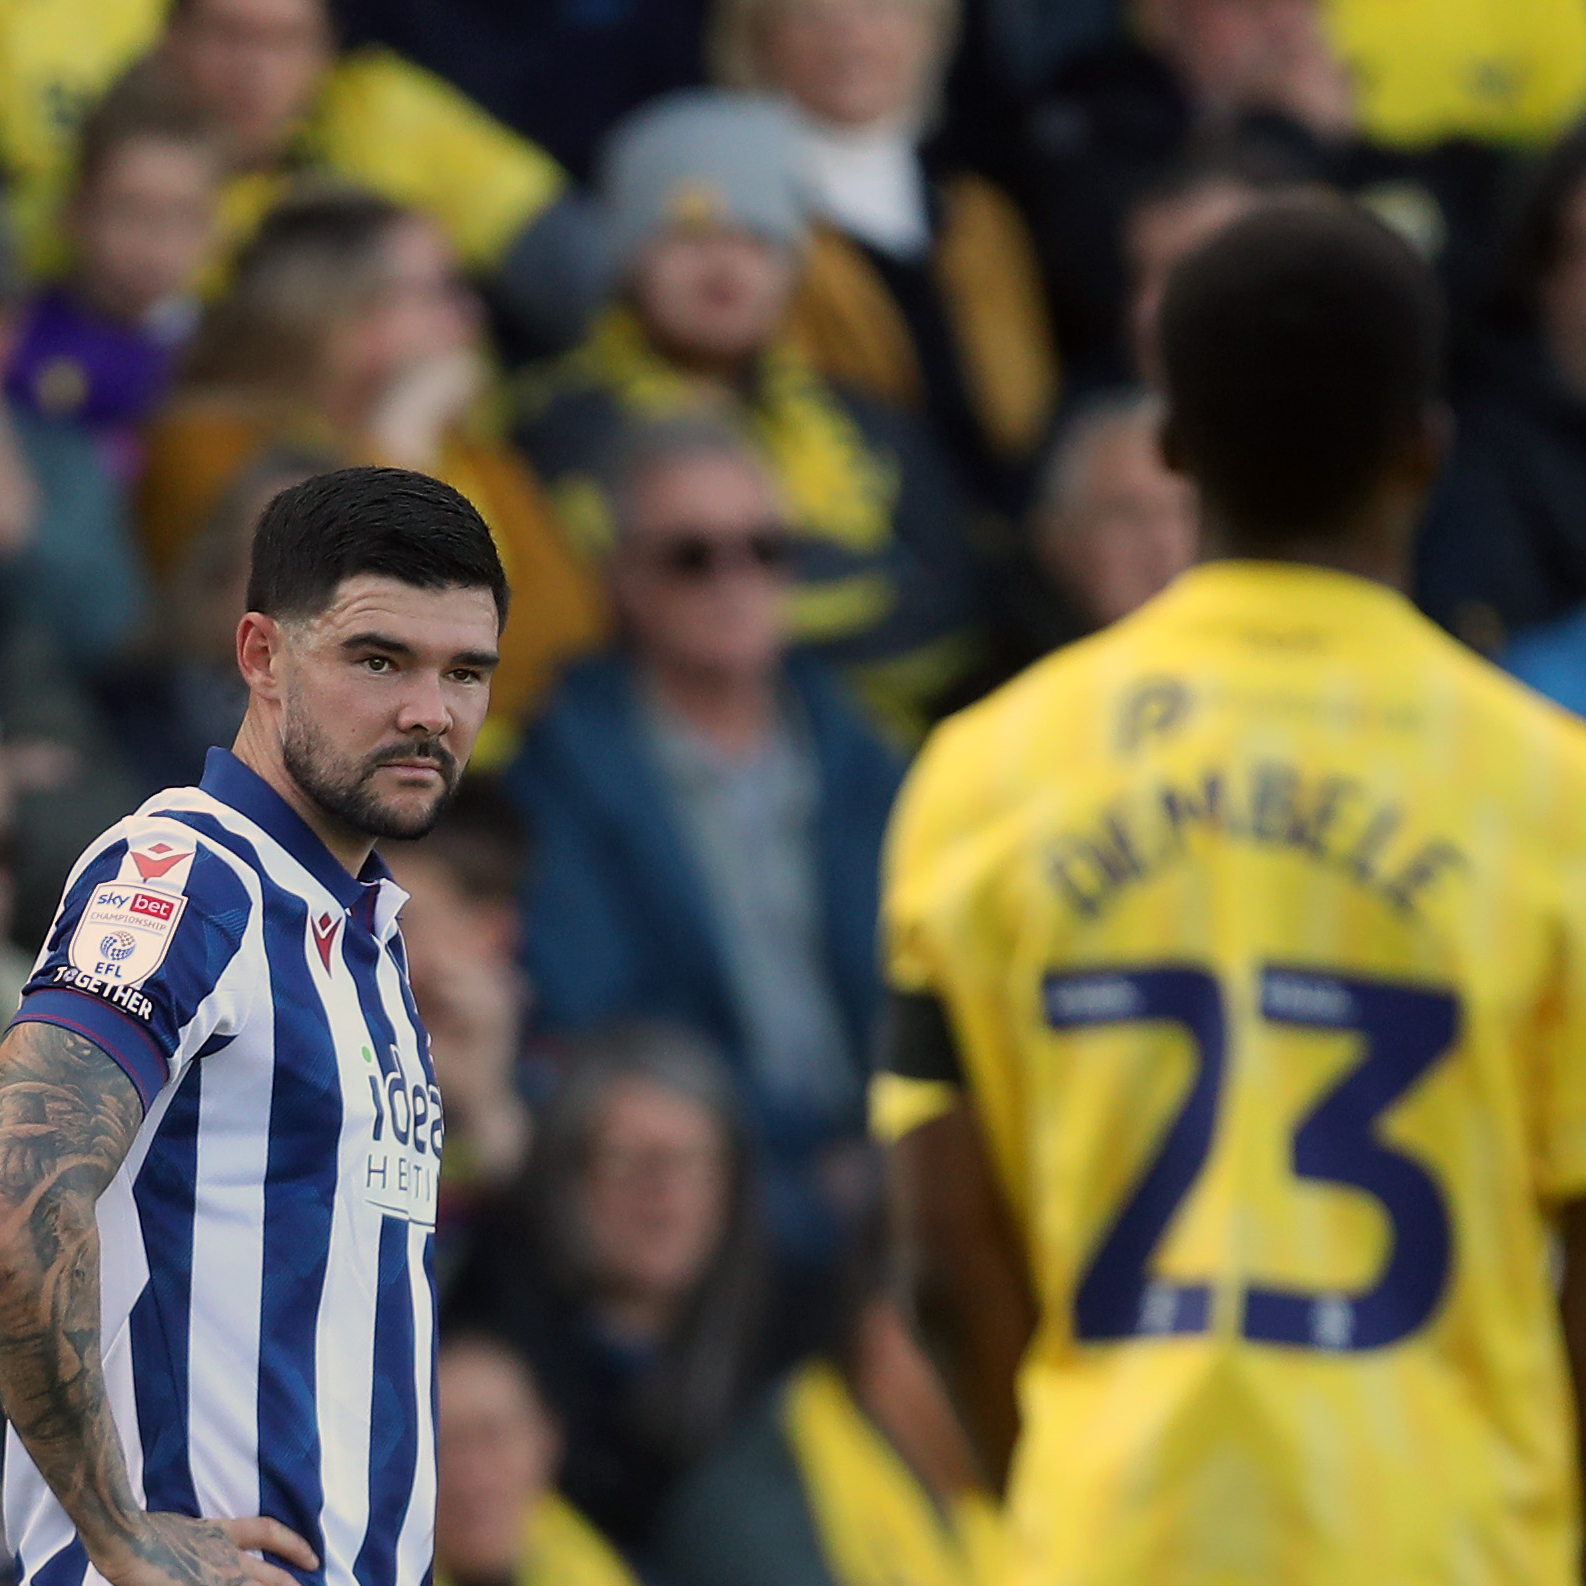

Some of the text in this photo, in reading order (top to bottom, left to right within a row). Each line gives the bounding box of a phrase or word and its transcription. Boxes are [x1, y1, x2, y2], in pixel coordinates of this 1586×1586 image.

[97, 892, 171, 917] sky bet
[90, 911, 167, 931] CHAMPIONSHIP
[94, 962, 122, 978] EFL
[1040, 957, 1467, 1352] 23
